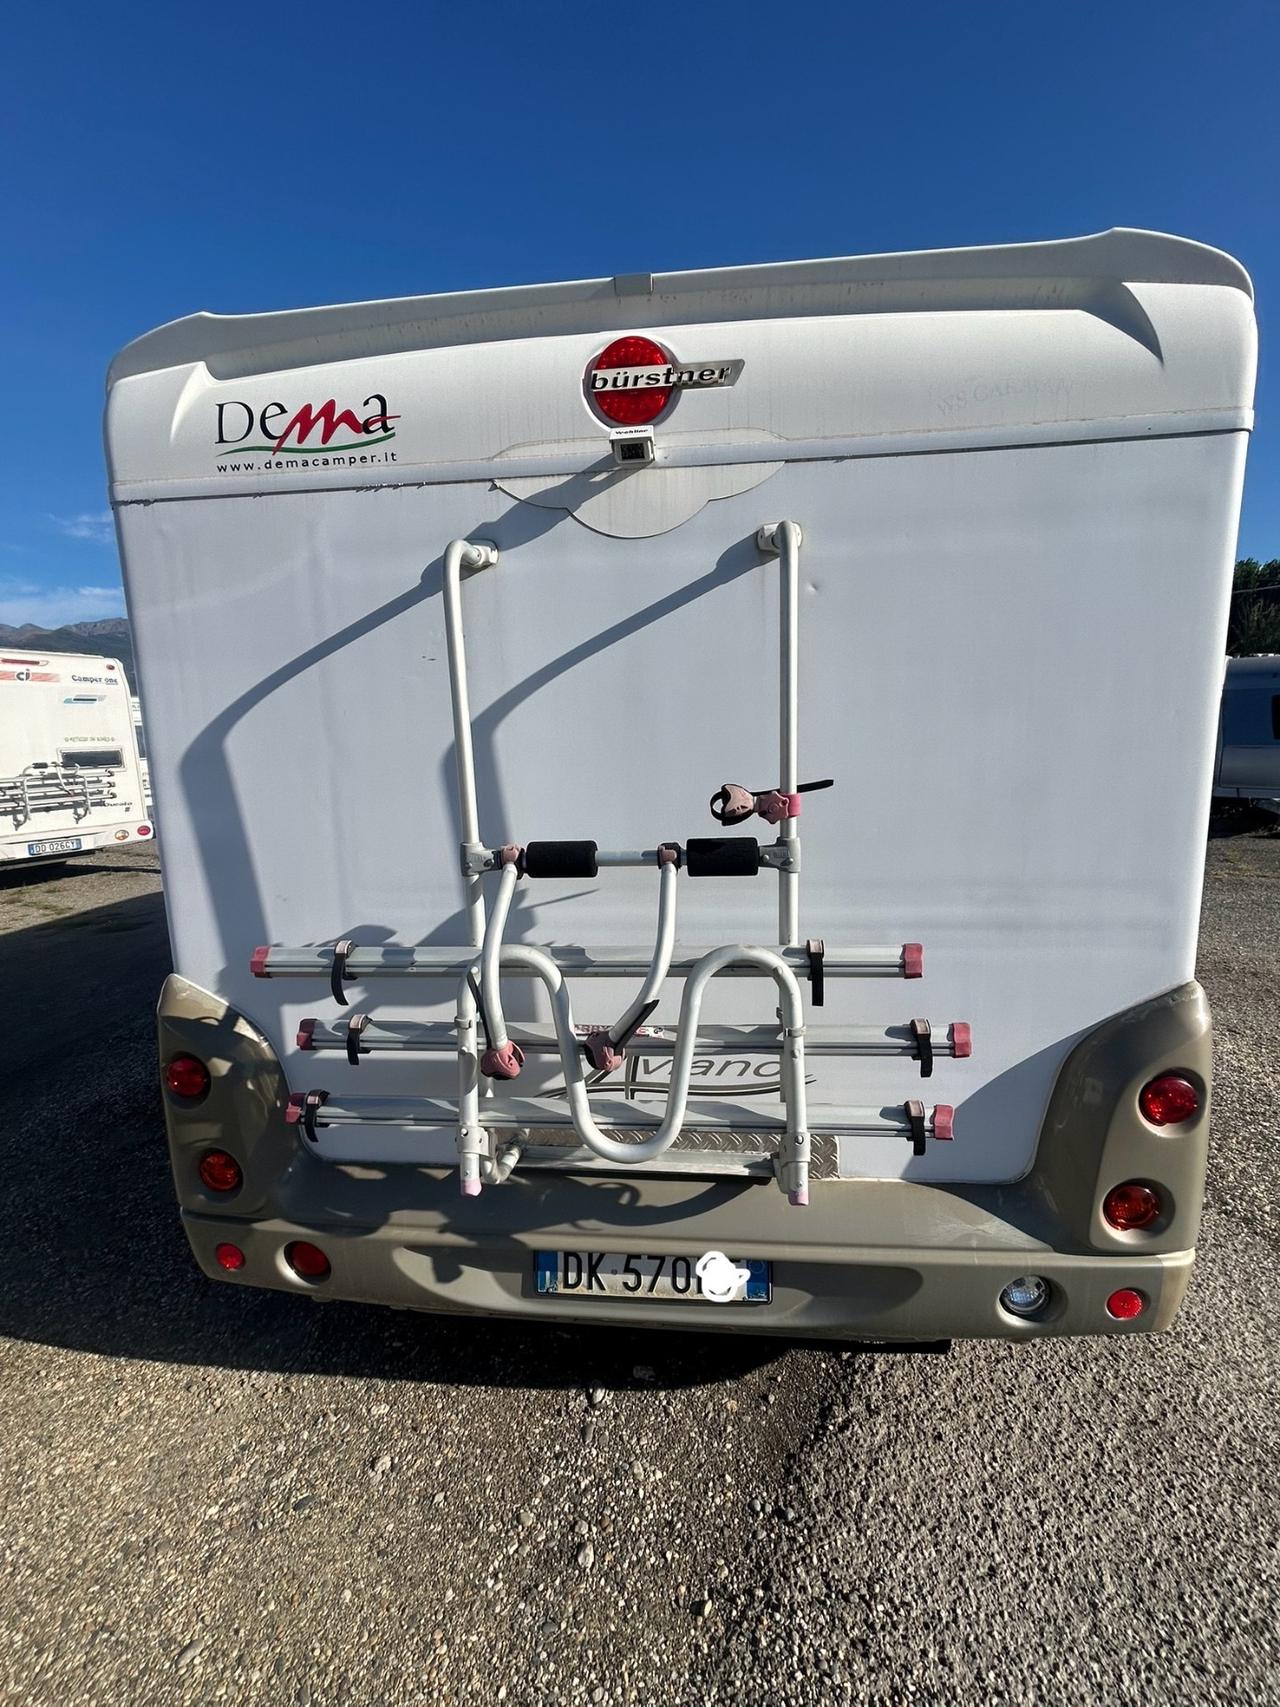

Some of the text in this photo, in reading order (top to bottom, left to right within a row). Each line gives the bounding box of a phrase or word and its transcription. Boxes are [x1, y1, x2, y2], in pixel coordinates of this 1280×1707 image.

[591, 366, 732, 390] bürstner
[214, 393, 401, 456] Dema
[216, 451, 398, 473] www.demacamper.it
[563, 1251, 606, 1291] DK
